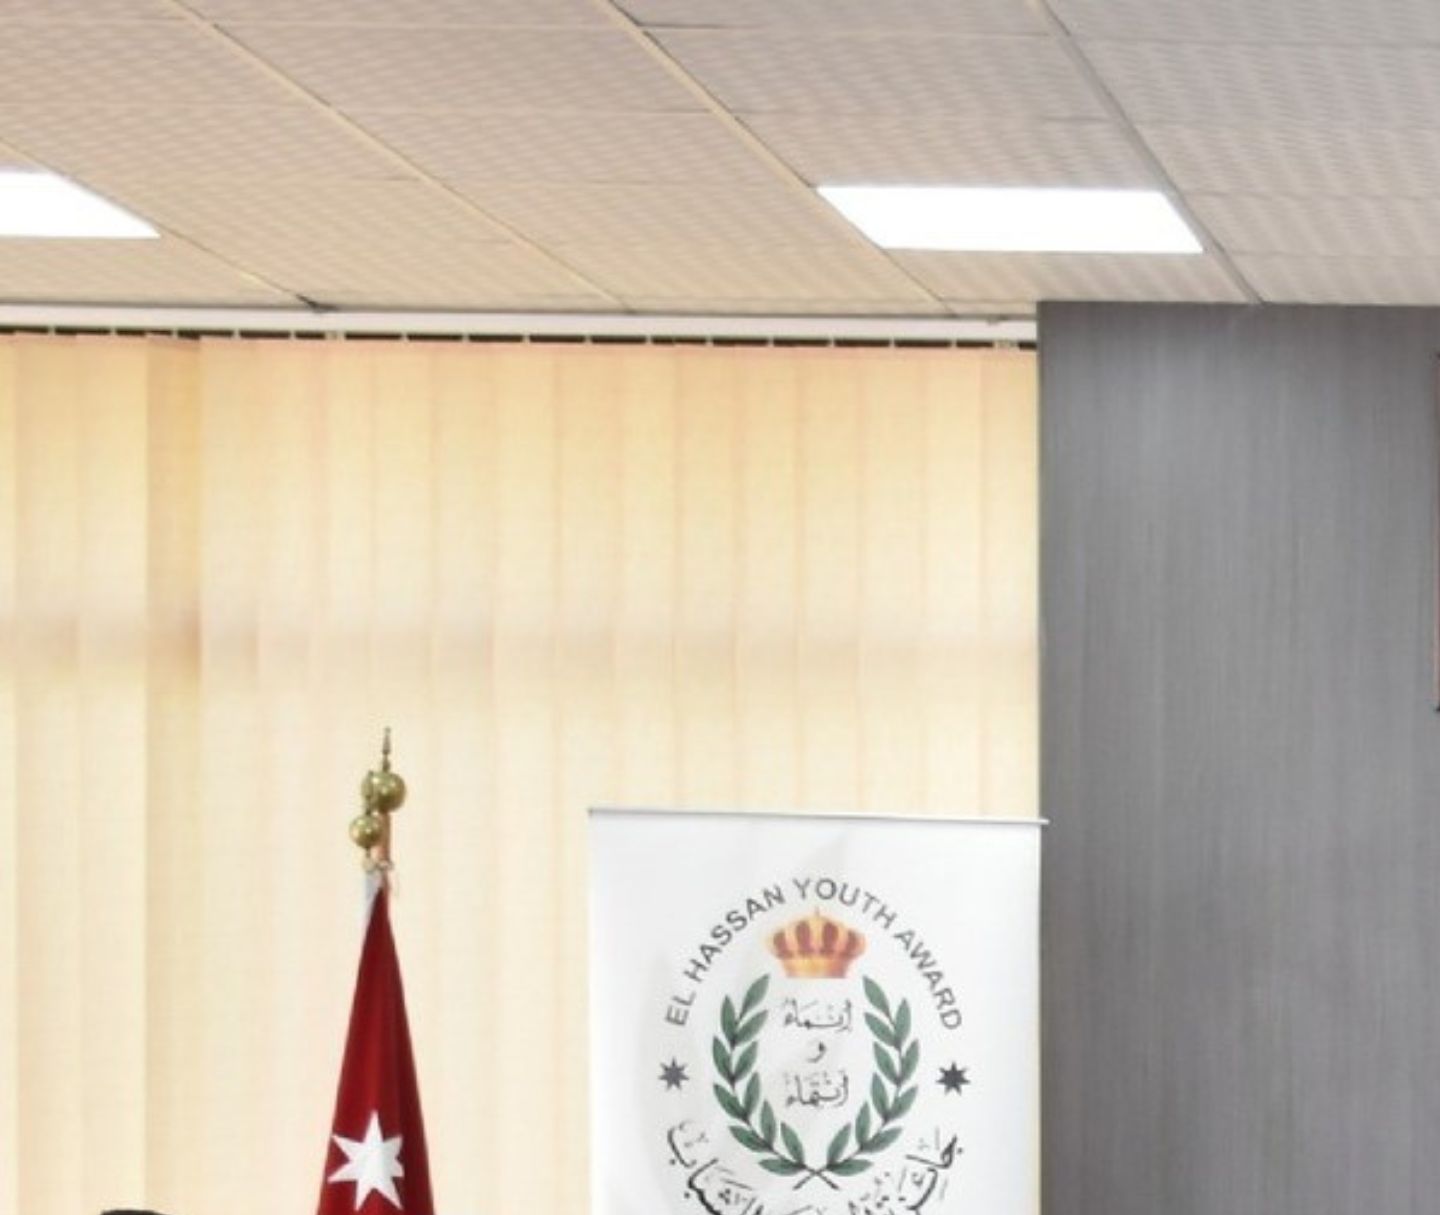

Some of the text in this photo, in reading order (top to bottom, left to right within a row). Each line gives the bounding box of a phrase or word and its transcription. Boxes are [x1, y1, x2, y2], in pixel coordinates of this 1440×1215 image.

[664, 877, 963, 1031] EL HASSAN YOUTH AWARD
